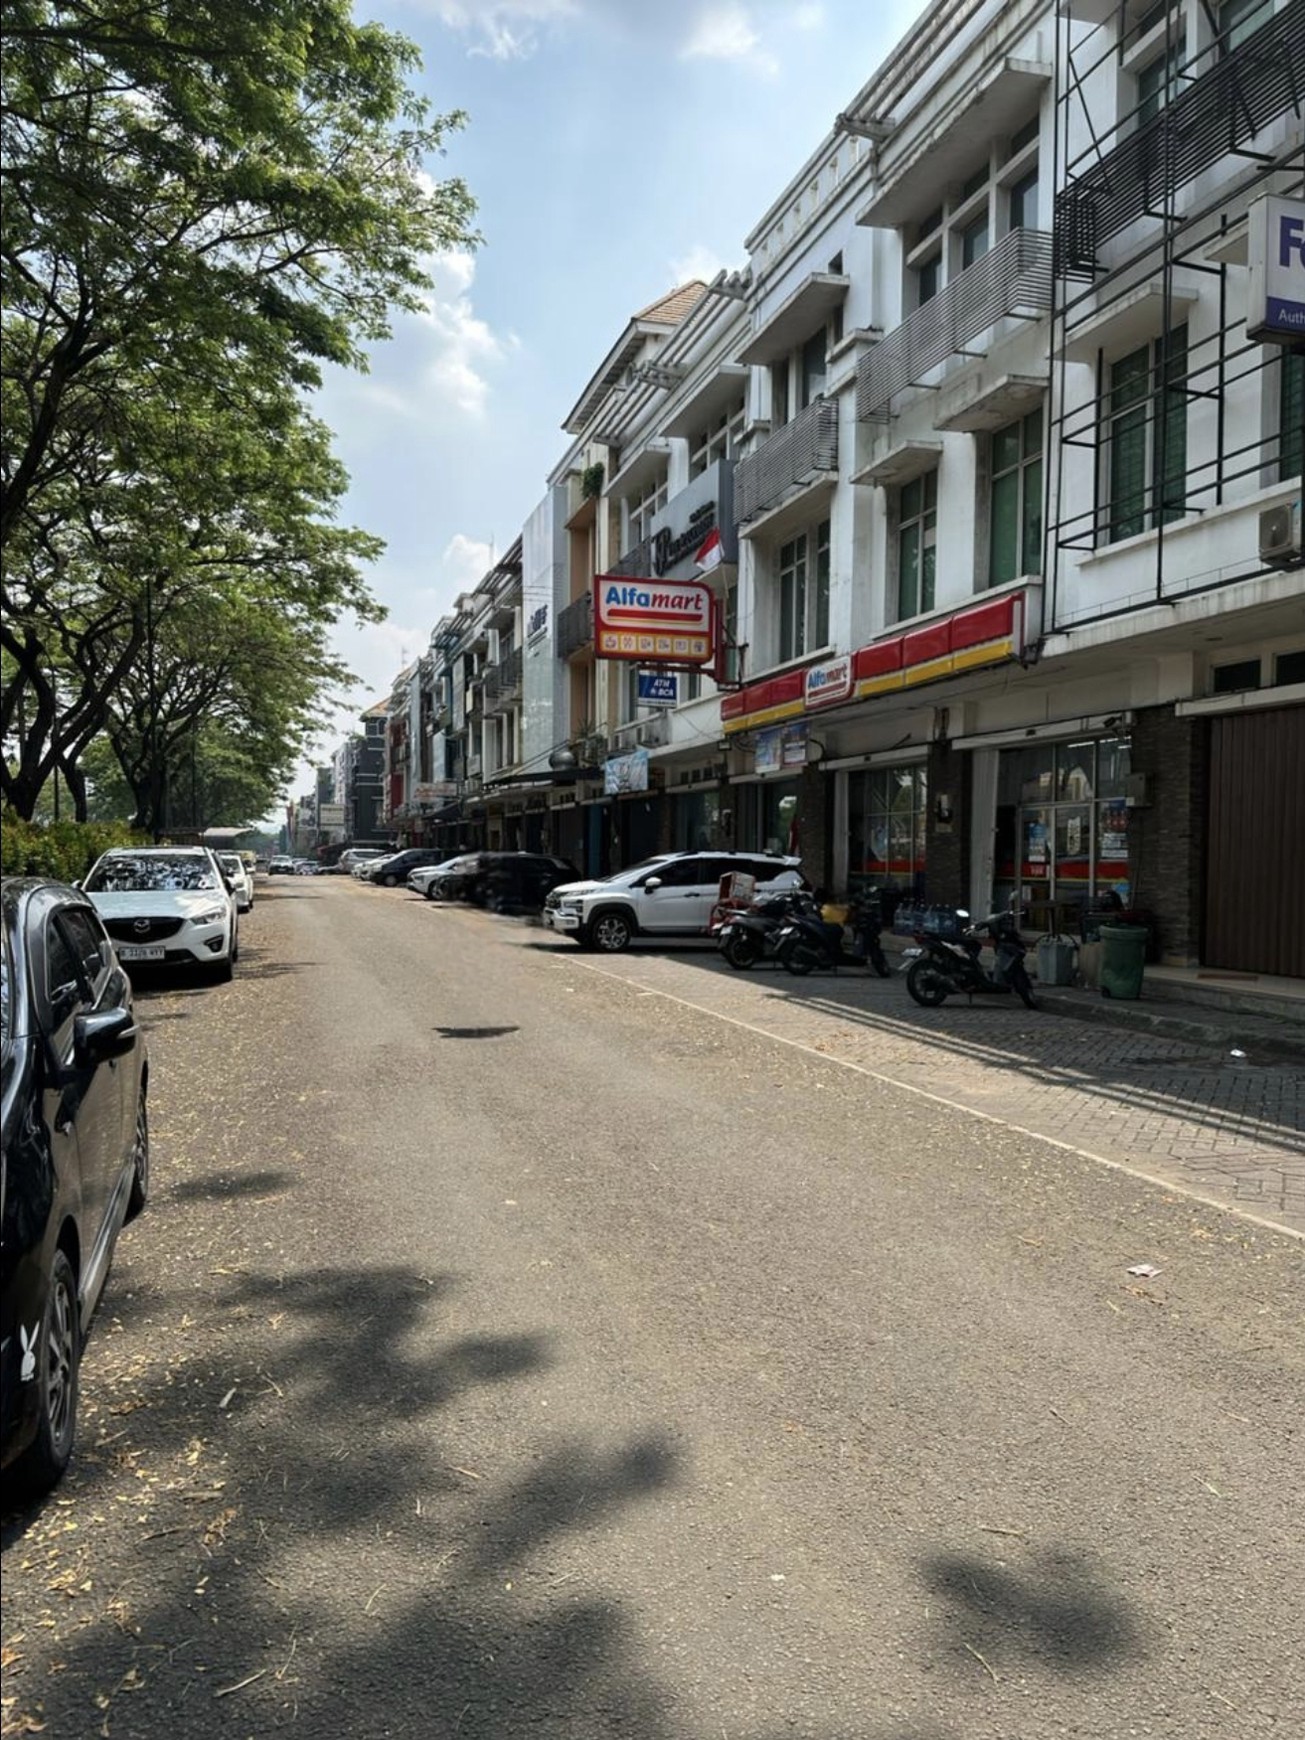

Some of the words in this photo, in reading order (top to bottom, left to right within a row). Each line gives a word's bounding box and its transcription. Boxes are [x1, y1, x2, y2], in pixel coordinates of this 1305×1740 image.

[1280, 216, 1305, 268] F
[605, 586, 704, 611] Alfamart
[654, 679, 670, 687] ATM
[808, 663, 847, 689] Alfamart
[658, 688, 674, 697] BCA
